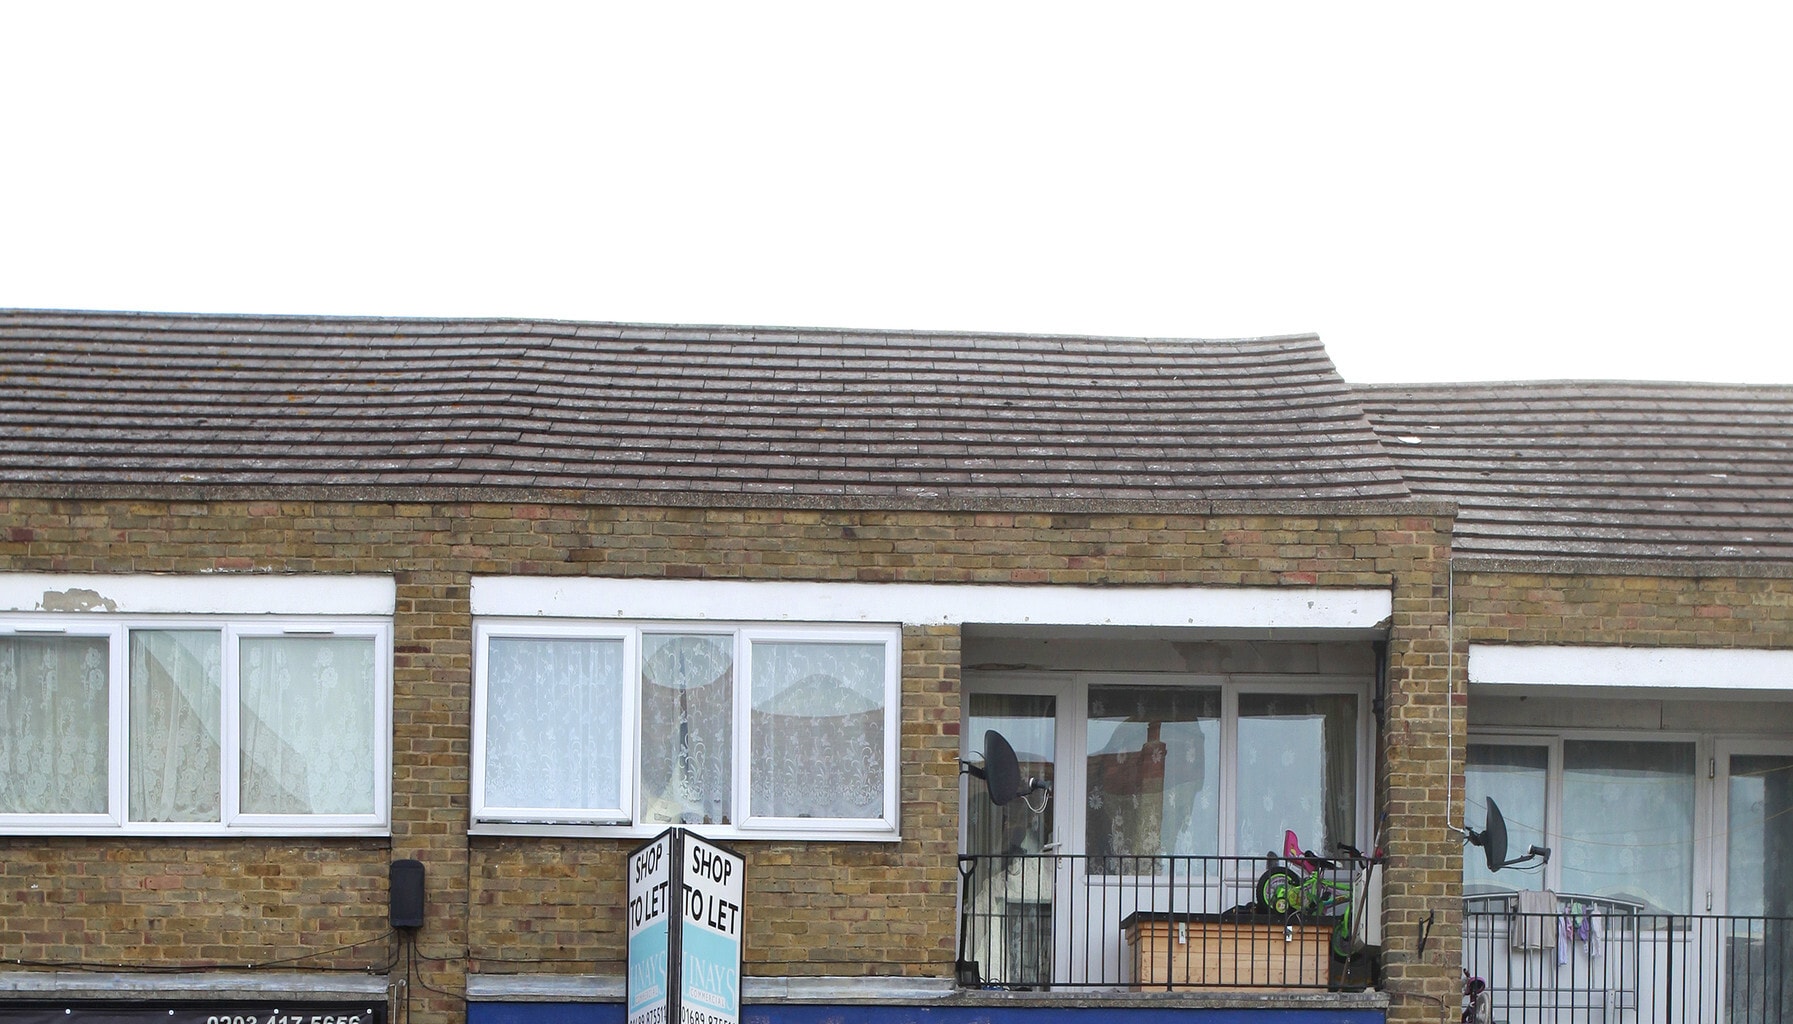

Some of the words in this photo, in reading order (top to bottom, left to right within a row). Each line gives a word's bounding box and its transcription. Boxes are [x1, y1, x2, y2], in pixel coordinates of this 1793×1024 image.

[636, 843, 662, 883] SHOP
[692, 845, 732, 886] SHOP
[630, 895, 643, 931] TO
[645, 880, 668, 921] LET
[683, 882, 704, 921] TO
[708, 895, 739, 934] LET
[682, 951, 735, 1011] LINAYS
[690, 988, 725, 1008] COMMERCIAL
